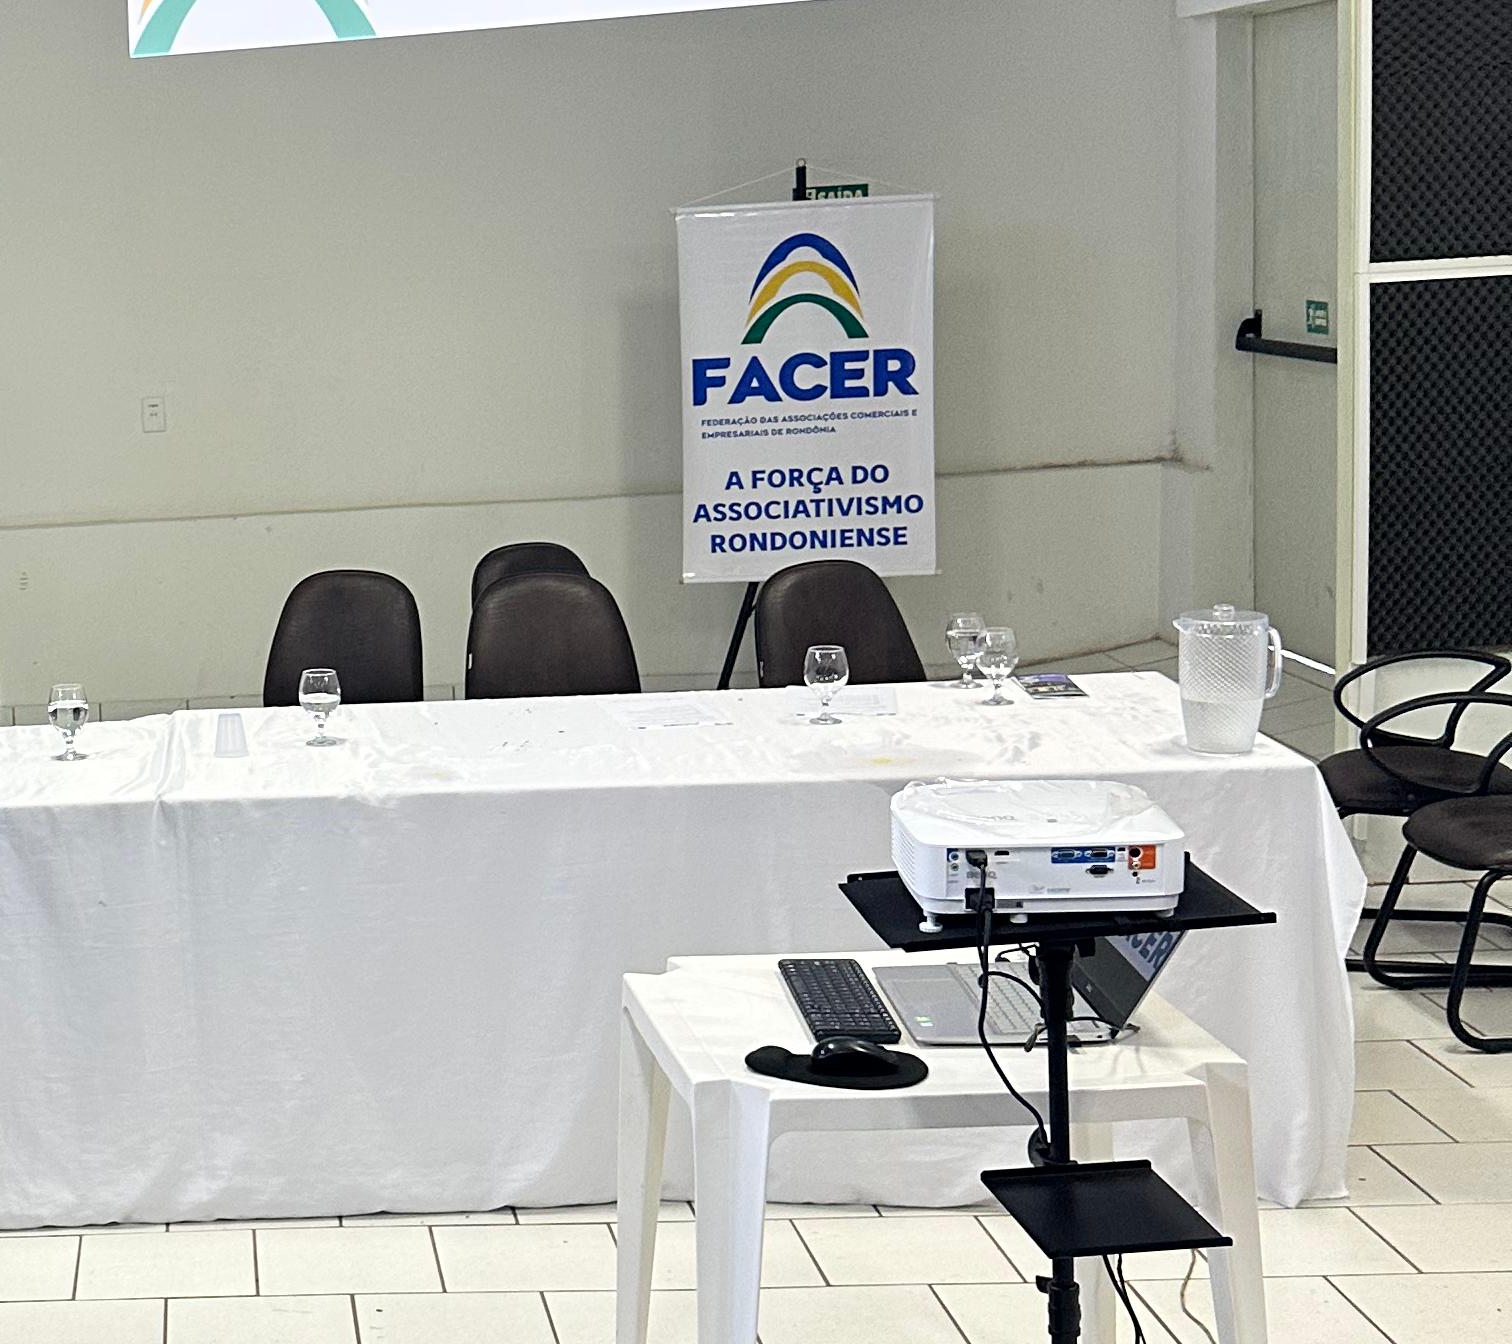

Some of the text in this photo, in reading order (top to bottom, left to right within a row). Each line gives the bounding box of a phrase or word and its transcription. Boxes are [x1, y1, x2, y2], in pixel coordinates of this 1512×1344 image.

[691, 347, 919, 406] FACER
[701, 409, 918, 427] FEDERAÇÃO DAS ASSOCIAÇÕES COMERCIAIS E
[701, 425, 836, 439] EMPRESARIAIS DE RONDÔNIA
[725, 464, 889, 494] A FORÇA DO
[692, 494, 924, 524] ASSOCIATIVISMO
[710, 526, 909, 554] RONDONIENSE
